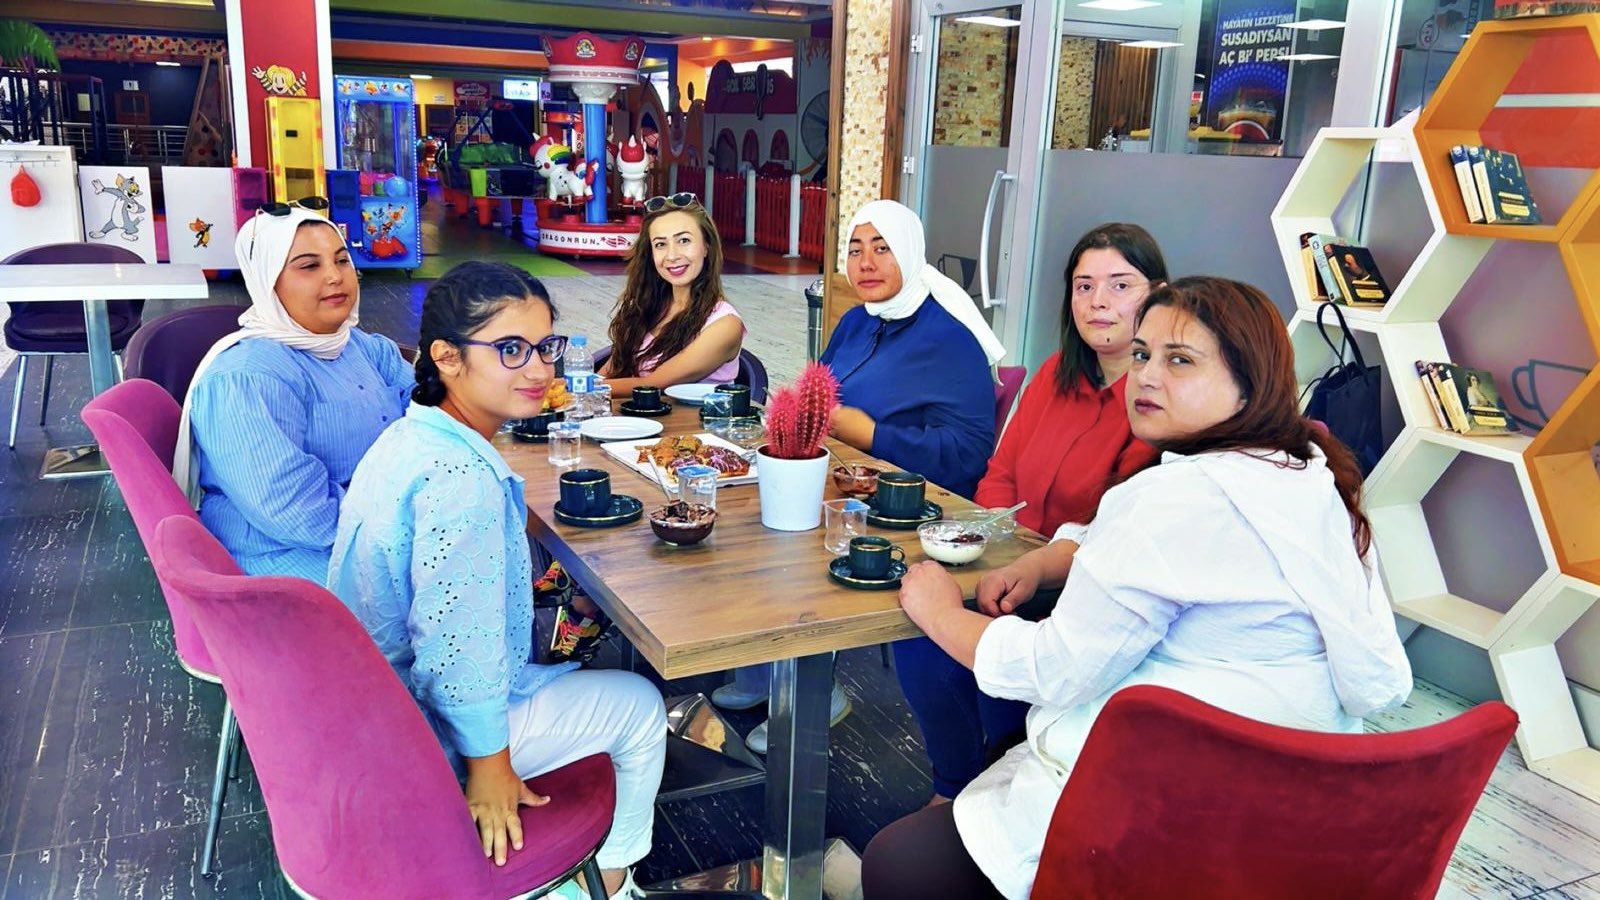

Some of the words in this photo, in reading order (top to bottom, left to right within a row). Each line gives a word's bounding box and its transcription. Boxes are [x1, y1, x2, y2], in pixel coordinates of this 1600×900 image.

[1223, 19, 1253, 30] HAYATIN
[1221, 28, 1292, 46] SUSADIYSAN
[1219, 50, 1235, 67] AÇ
